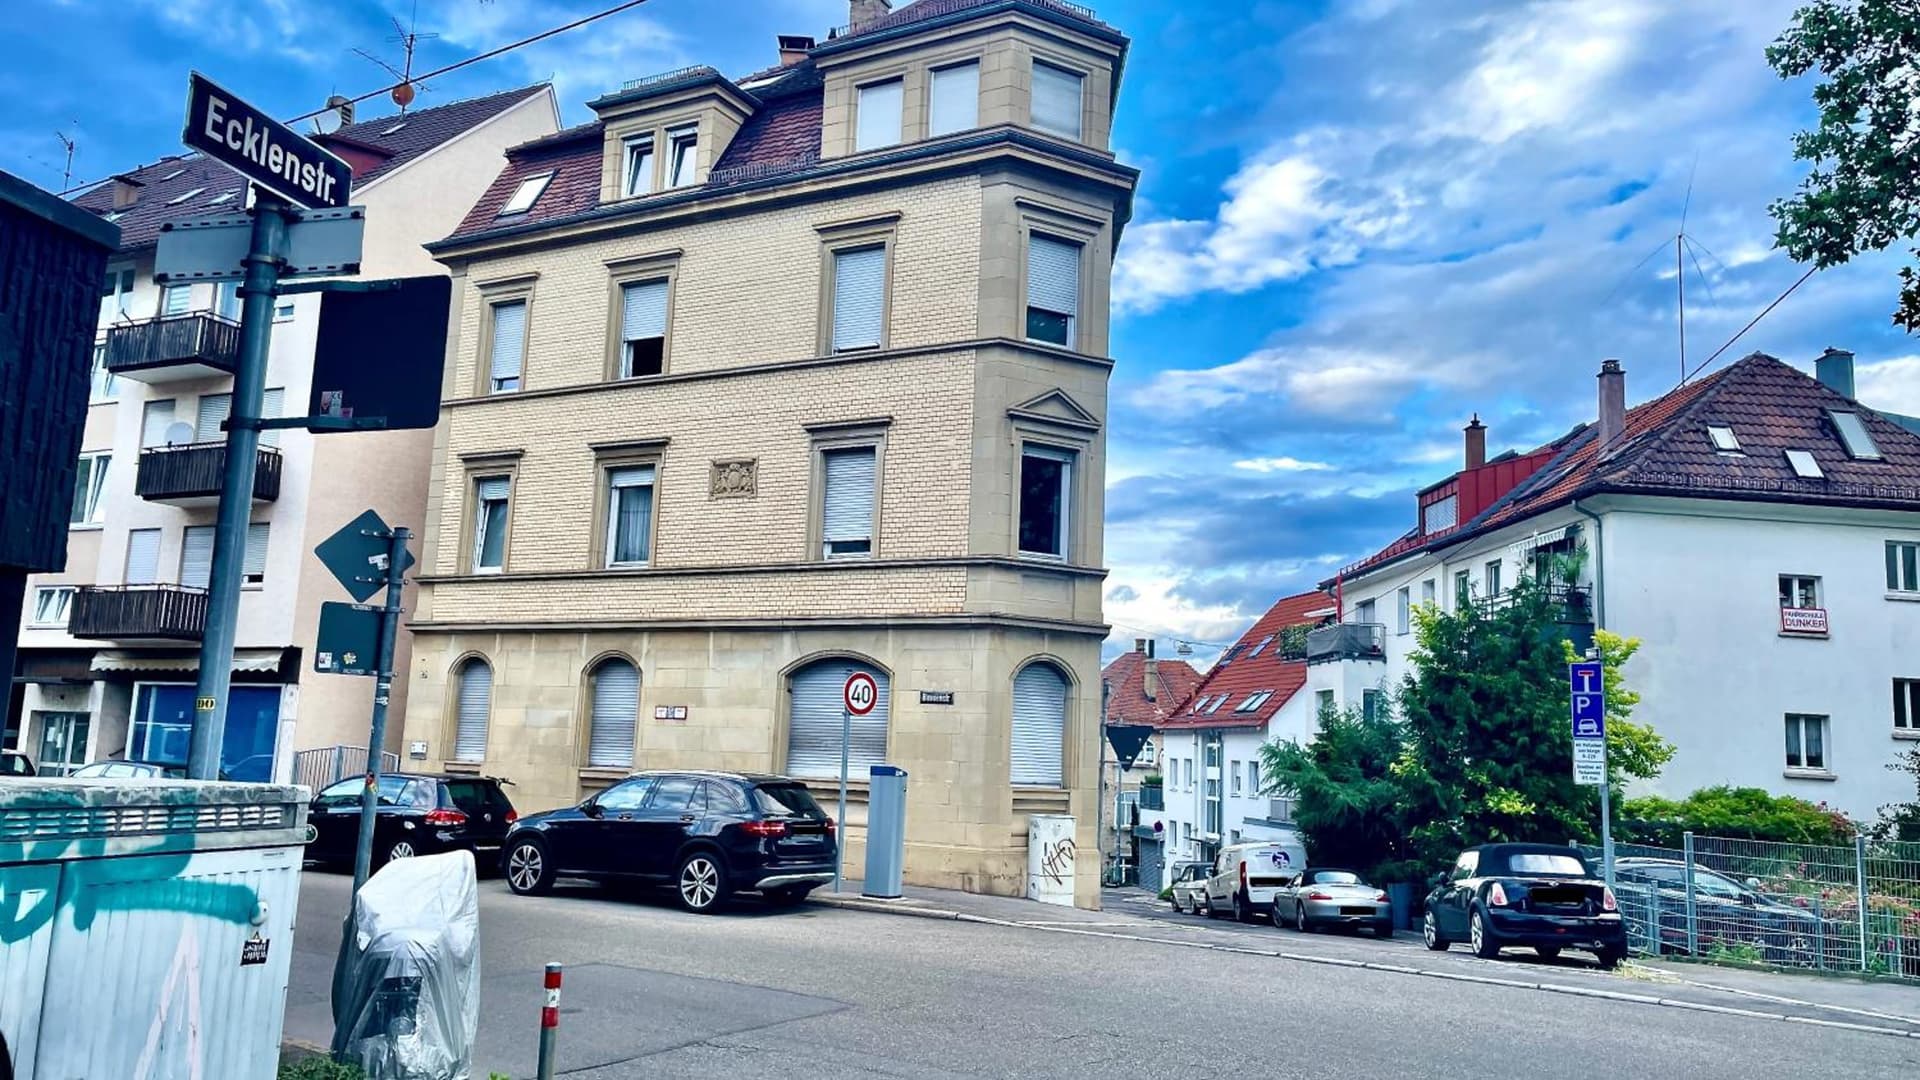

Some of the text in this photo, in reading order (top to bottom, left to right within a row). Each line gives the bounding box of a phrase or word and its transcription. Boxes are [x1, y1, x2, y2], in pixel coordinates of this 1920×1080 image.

[205, 94, 336, 205] Ecklenstr.
[1785, 618, 1826, 629] DUNKER
[851, 684, 871, 704] 40
[1577, 696, 1590, 714] P
